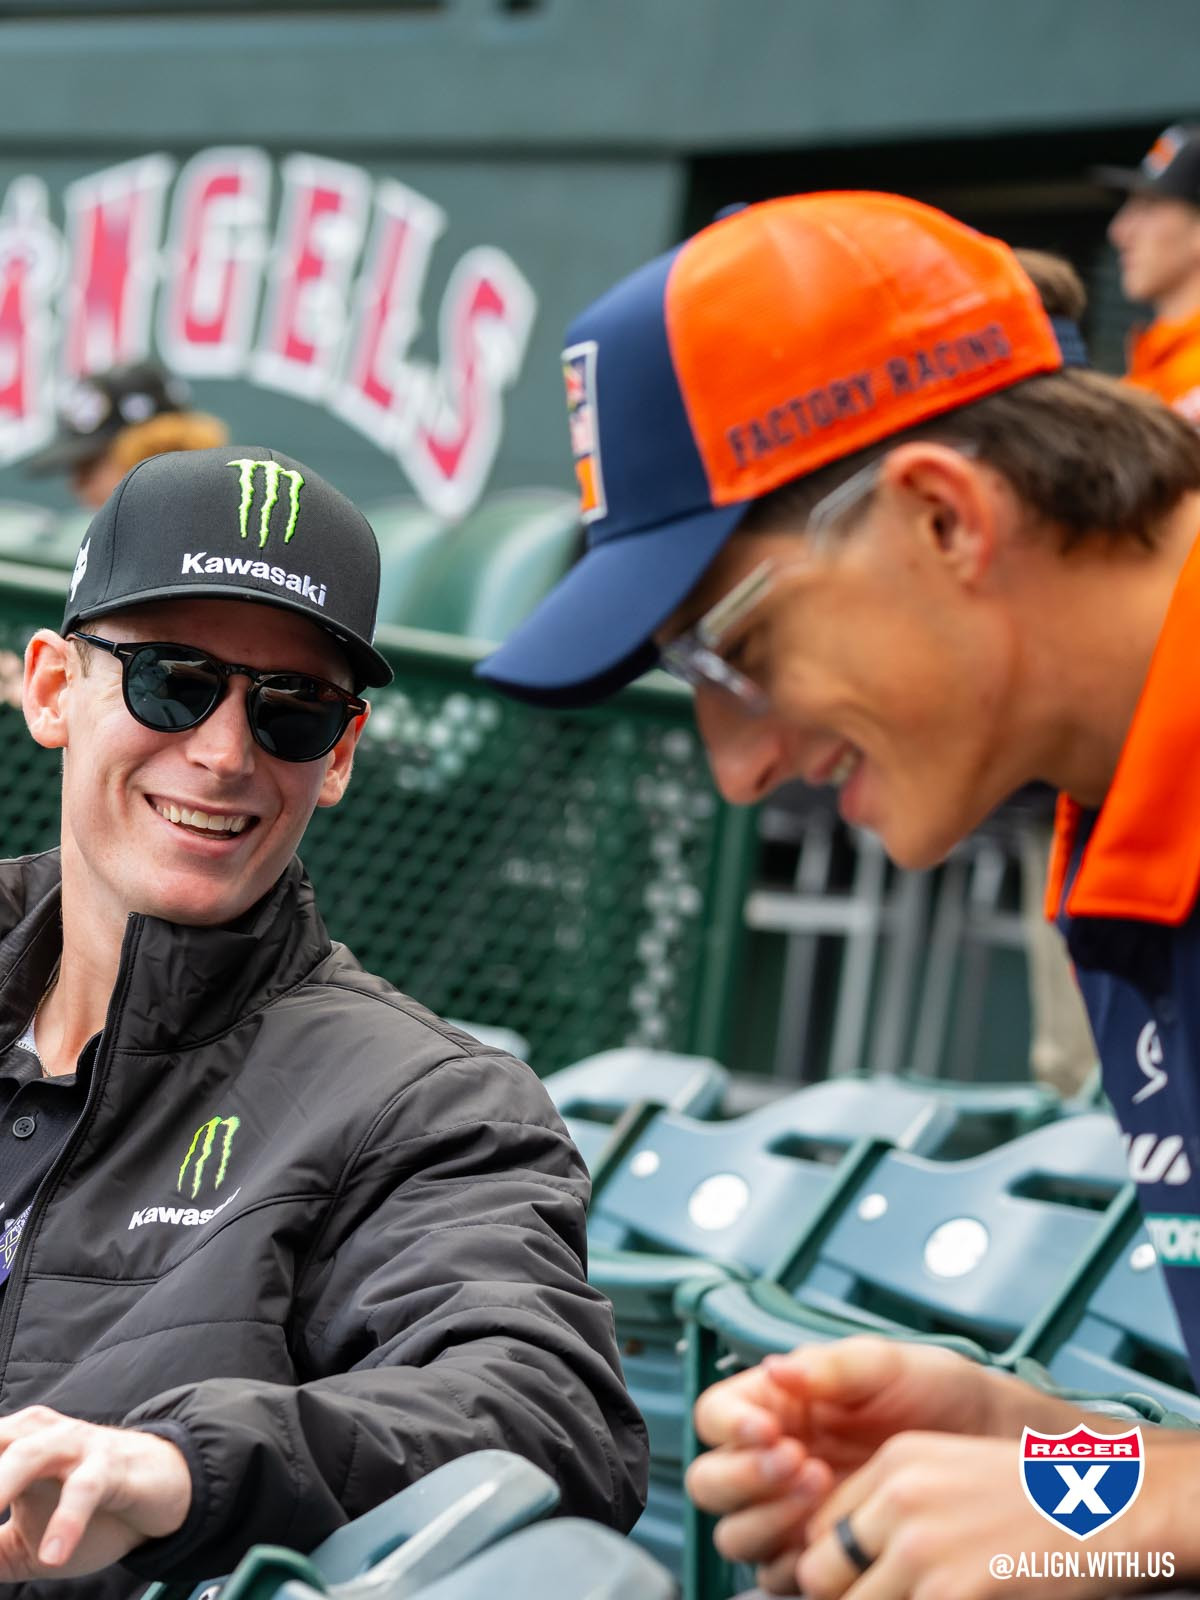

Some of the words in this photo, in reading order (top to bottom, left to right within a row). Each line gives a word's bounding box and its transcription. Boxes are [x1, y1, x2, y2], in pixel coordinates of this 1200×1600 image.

[726, 372, 877, 468] FACTORY
[885, 321, 1012, 397] RACING
[181, 551, 328, 607] Kawasaki
[127, 1186, 242, 1231] Kawas
